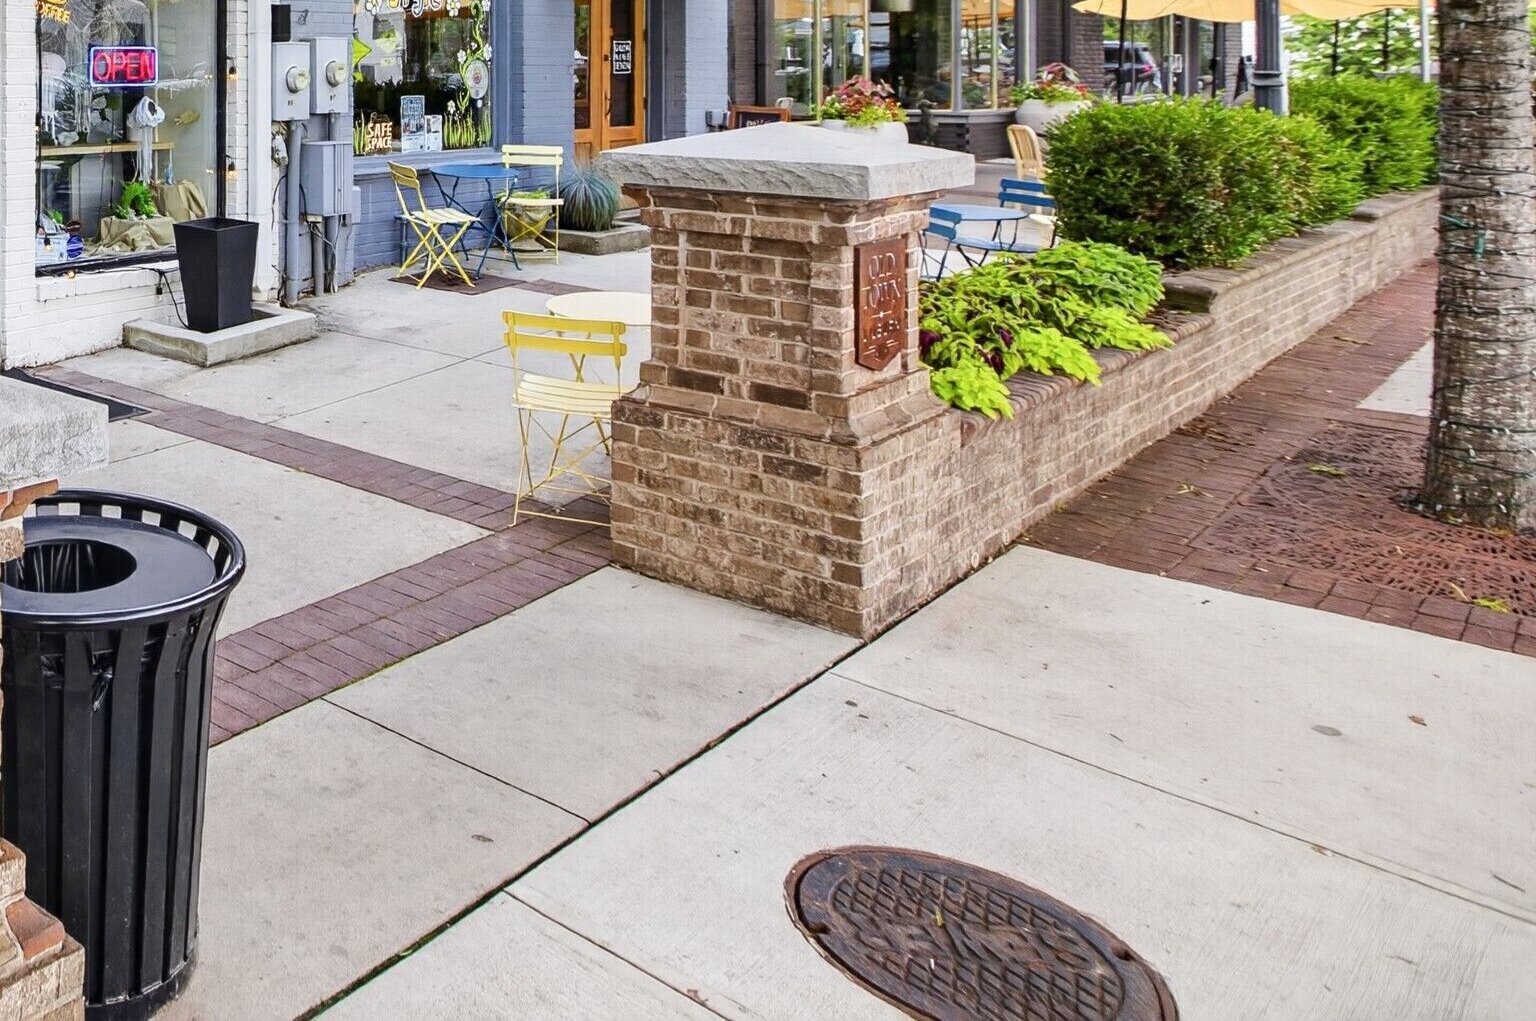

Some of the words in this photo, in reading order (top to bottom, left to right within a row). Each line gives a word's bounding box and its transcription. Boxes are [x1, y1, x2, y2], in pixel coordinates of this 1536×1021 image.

[93, 49, 156, 81] OPEN
[366, 121, 393, 138] SAFE
[365, 137, 393, 151] SPACE
